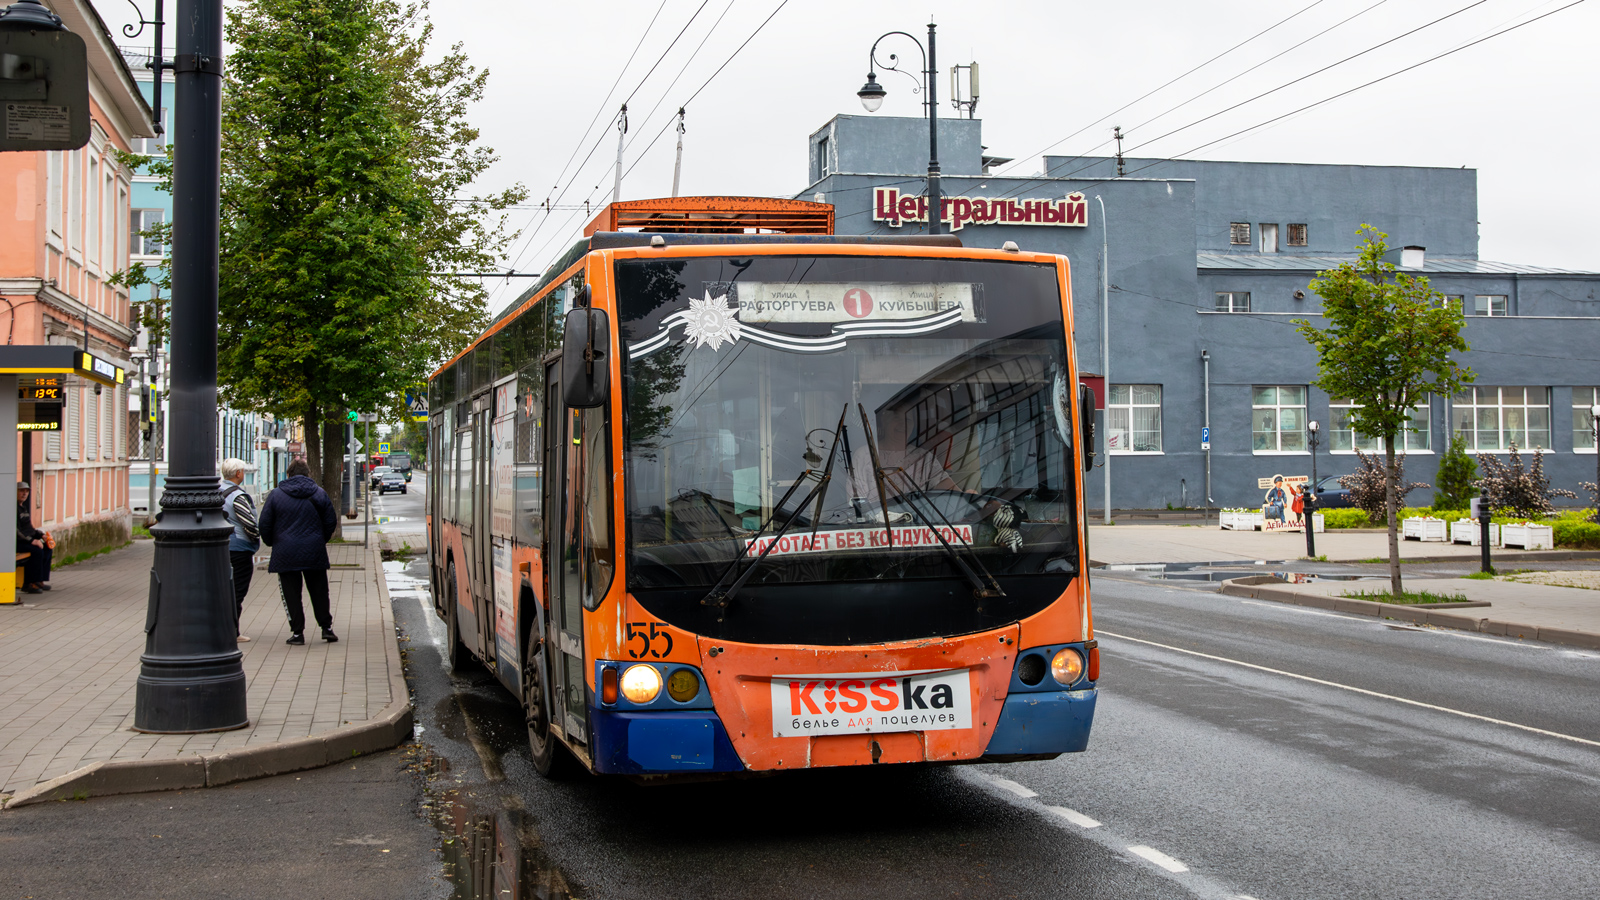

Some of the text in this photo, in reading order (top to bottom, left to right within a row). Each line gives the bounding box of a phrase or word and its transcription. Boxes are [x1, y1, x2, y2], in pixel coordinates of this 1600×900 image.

[875, 188, 1087, 229] Центральный
[738, 300, 836, 312] РАСТОРГУЕВА
[850, 290, 863, 316] 1
[879, 299, 965, 312] КУЙБЫШЕВА
[746, 526, 973, 557] РАБОТАЕТ БЕЗ КОНДУКТОРА
[626, 623, 673, 659] 55
[792, 713, 955, 730] белье для поцелуев
